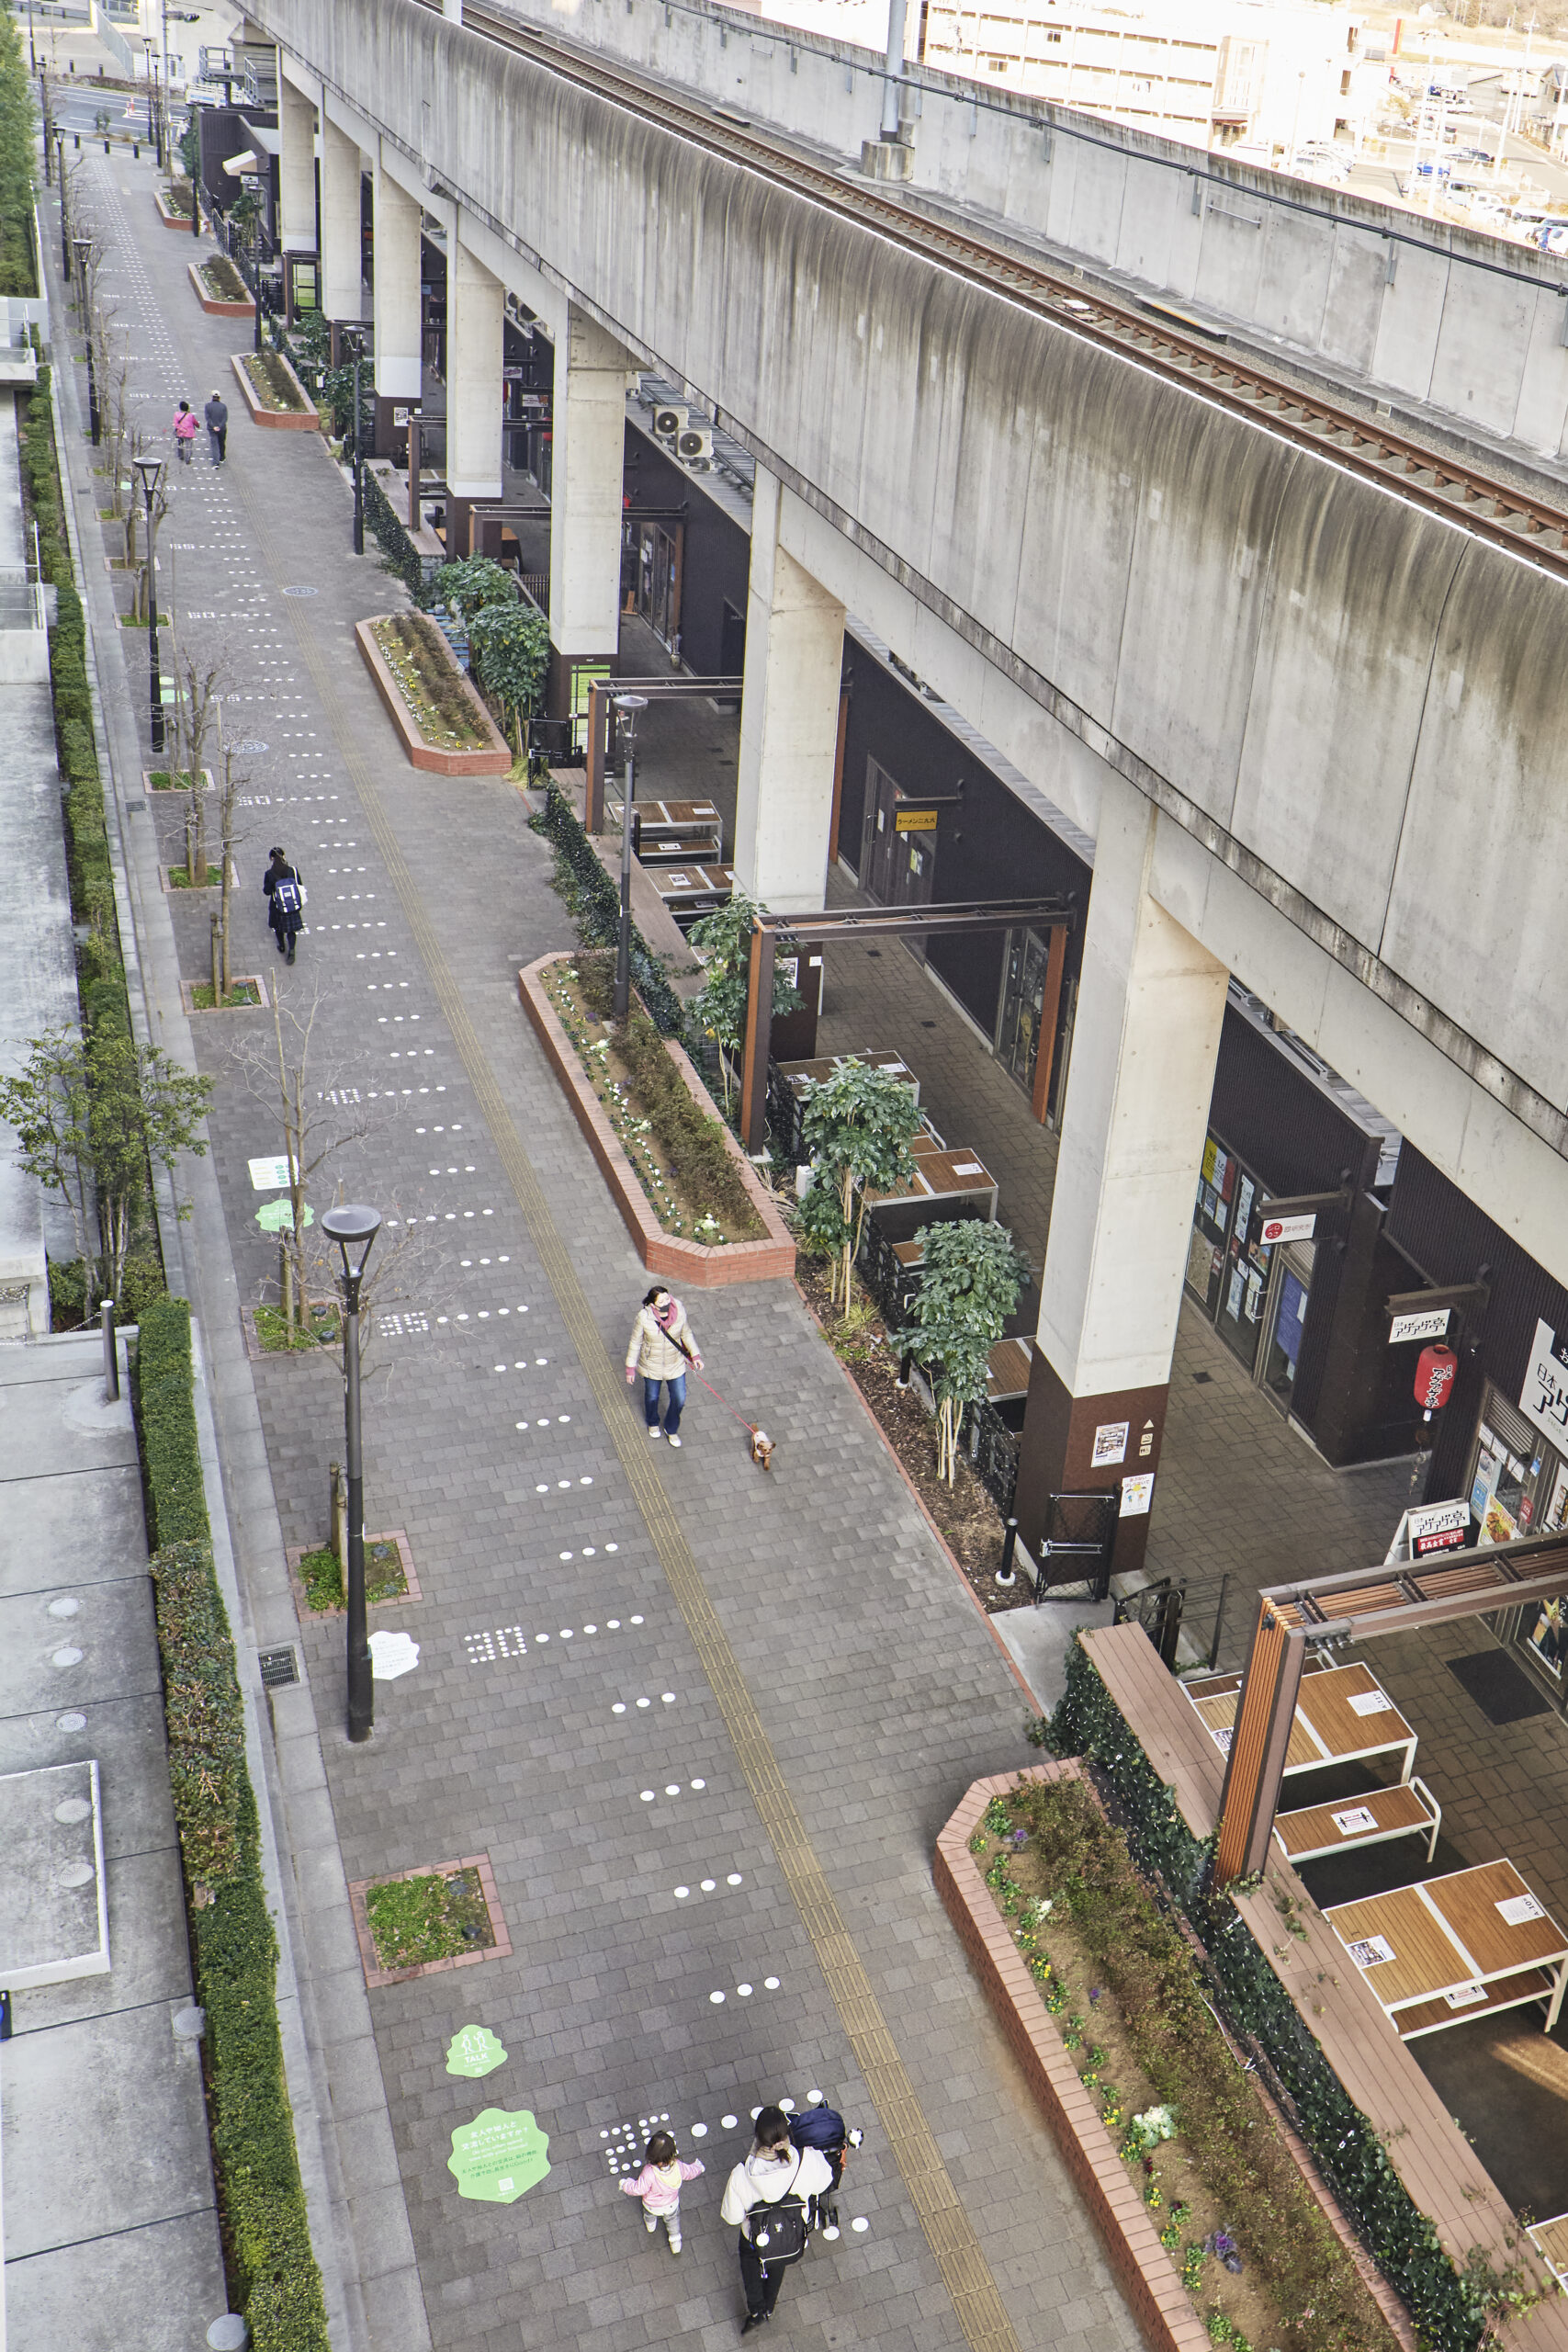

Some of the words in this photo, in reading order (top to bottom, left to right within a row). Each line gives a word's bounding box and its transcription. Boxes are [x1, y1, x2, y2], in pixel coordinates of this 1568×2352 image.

[376, 1311, 429, 1337] 35
[1537, 1363, 1557, 1391] 日本
[464, 1625, 527, 1664] 30
[464, 2052, 489, 2064] TALK
